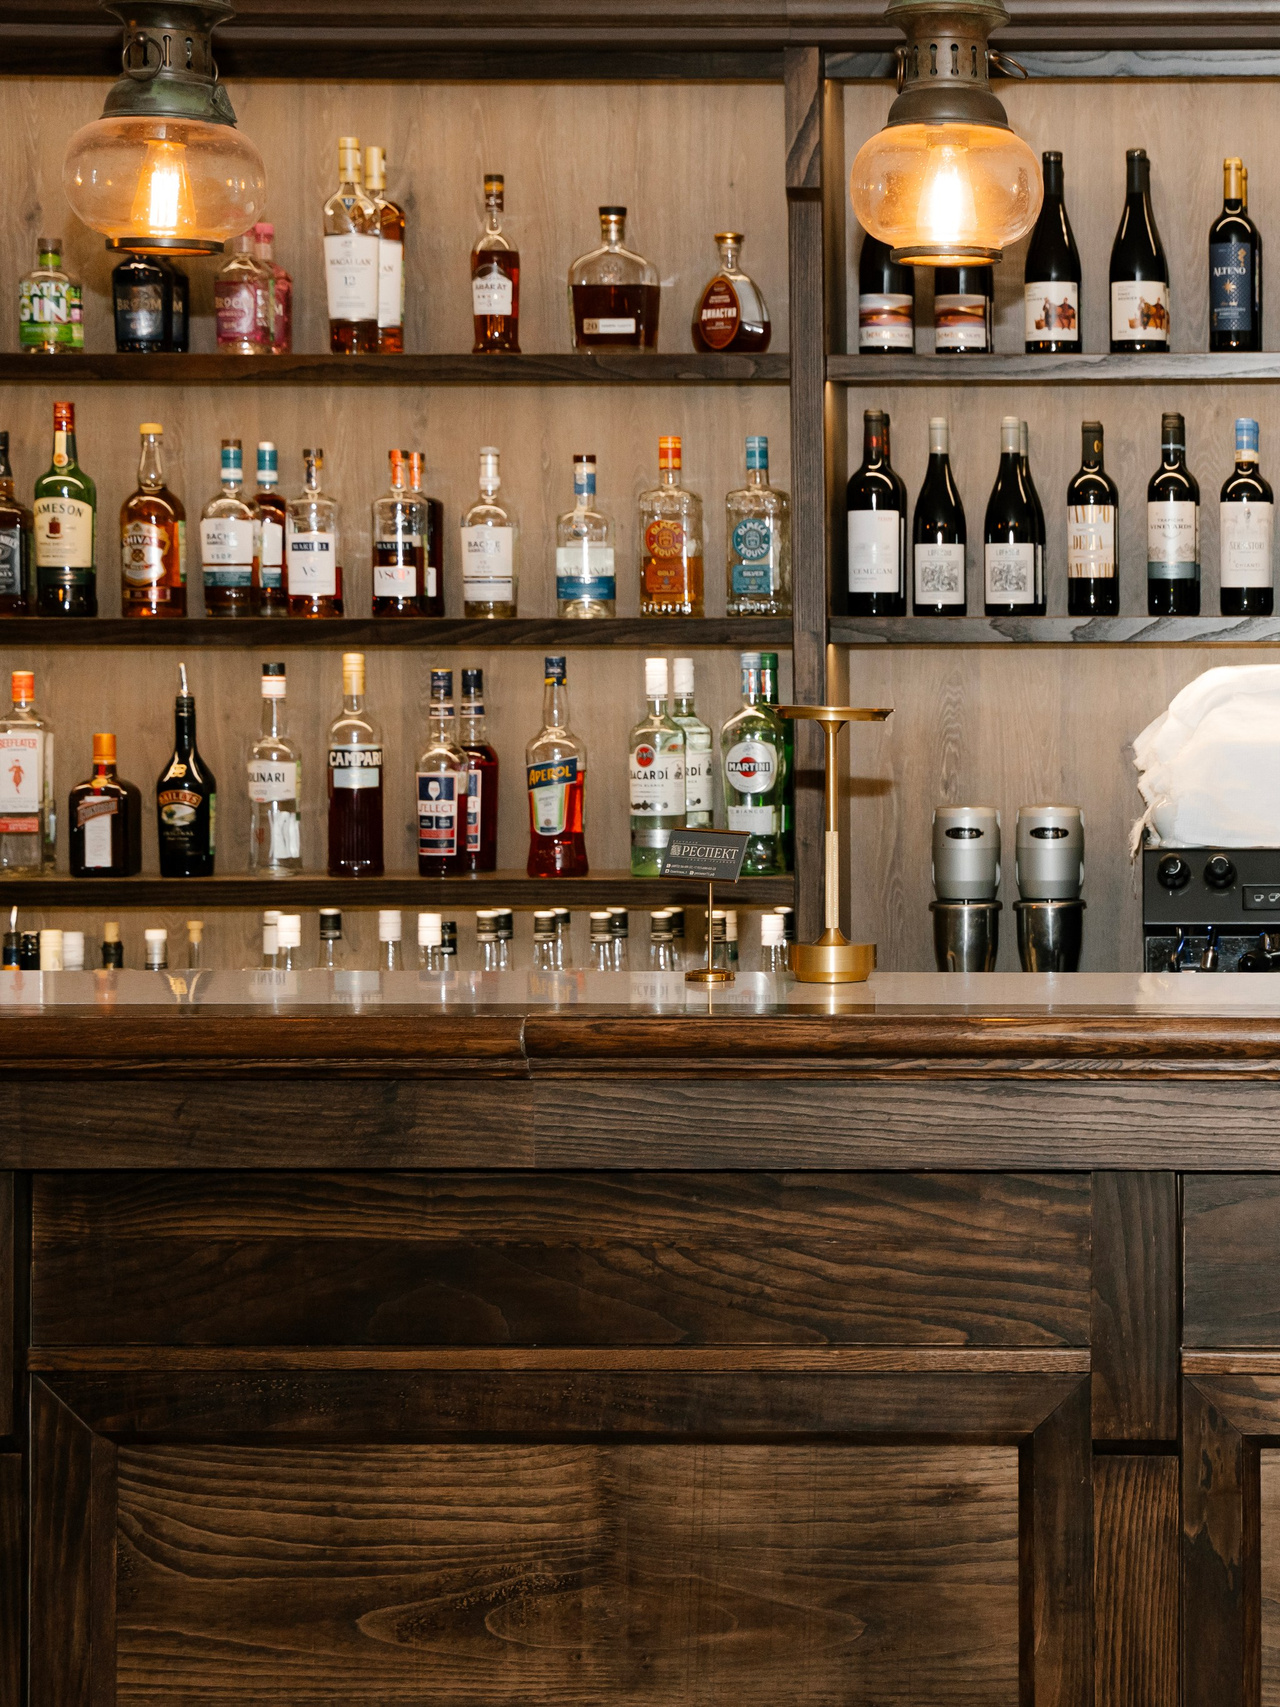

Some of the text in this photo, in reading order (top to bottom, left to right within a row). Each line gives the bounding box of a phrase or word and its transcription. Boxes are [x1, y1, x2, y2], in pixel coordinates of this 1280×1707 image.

[344, 275, 356, 287] 12
[20, 296, 67, 322] GIN
[738, 543, 769, 557] TEQUILA
[329, 751, 382, 767] CAMPARI
[728, 762, 770, 772] MARTINI
[529, 764, 573, 786] APEROL
[419, 803, 454, 813] SELECT
[681, 845, 739, 860] РЕСПЕКТ
